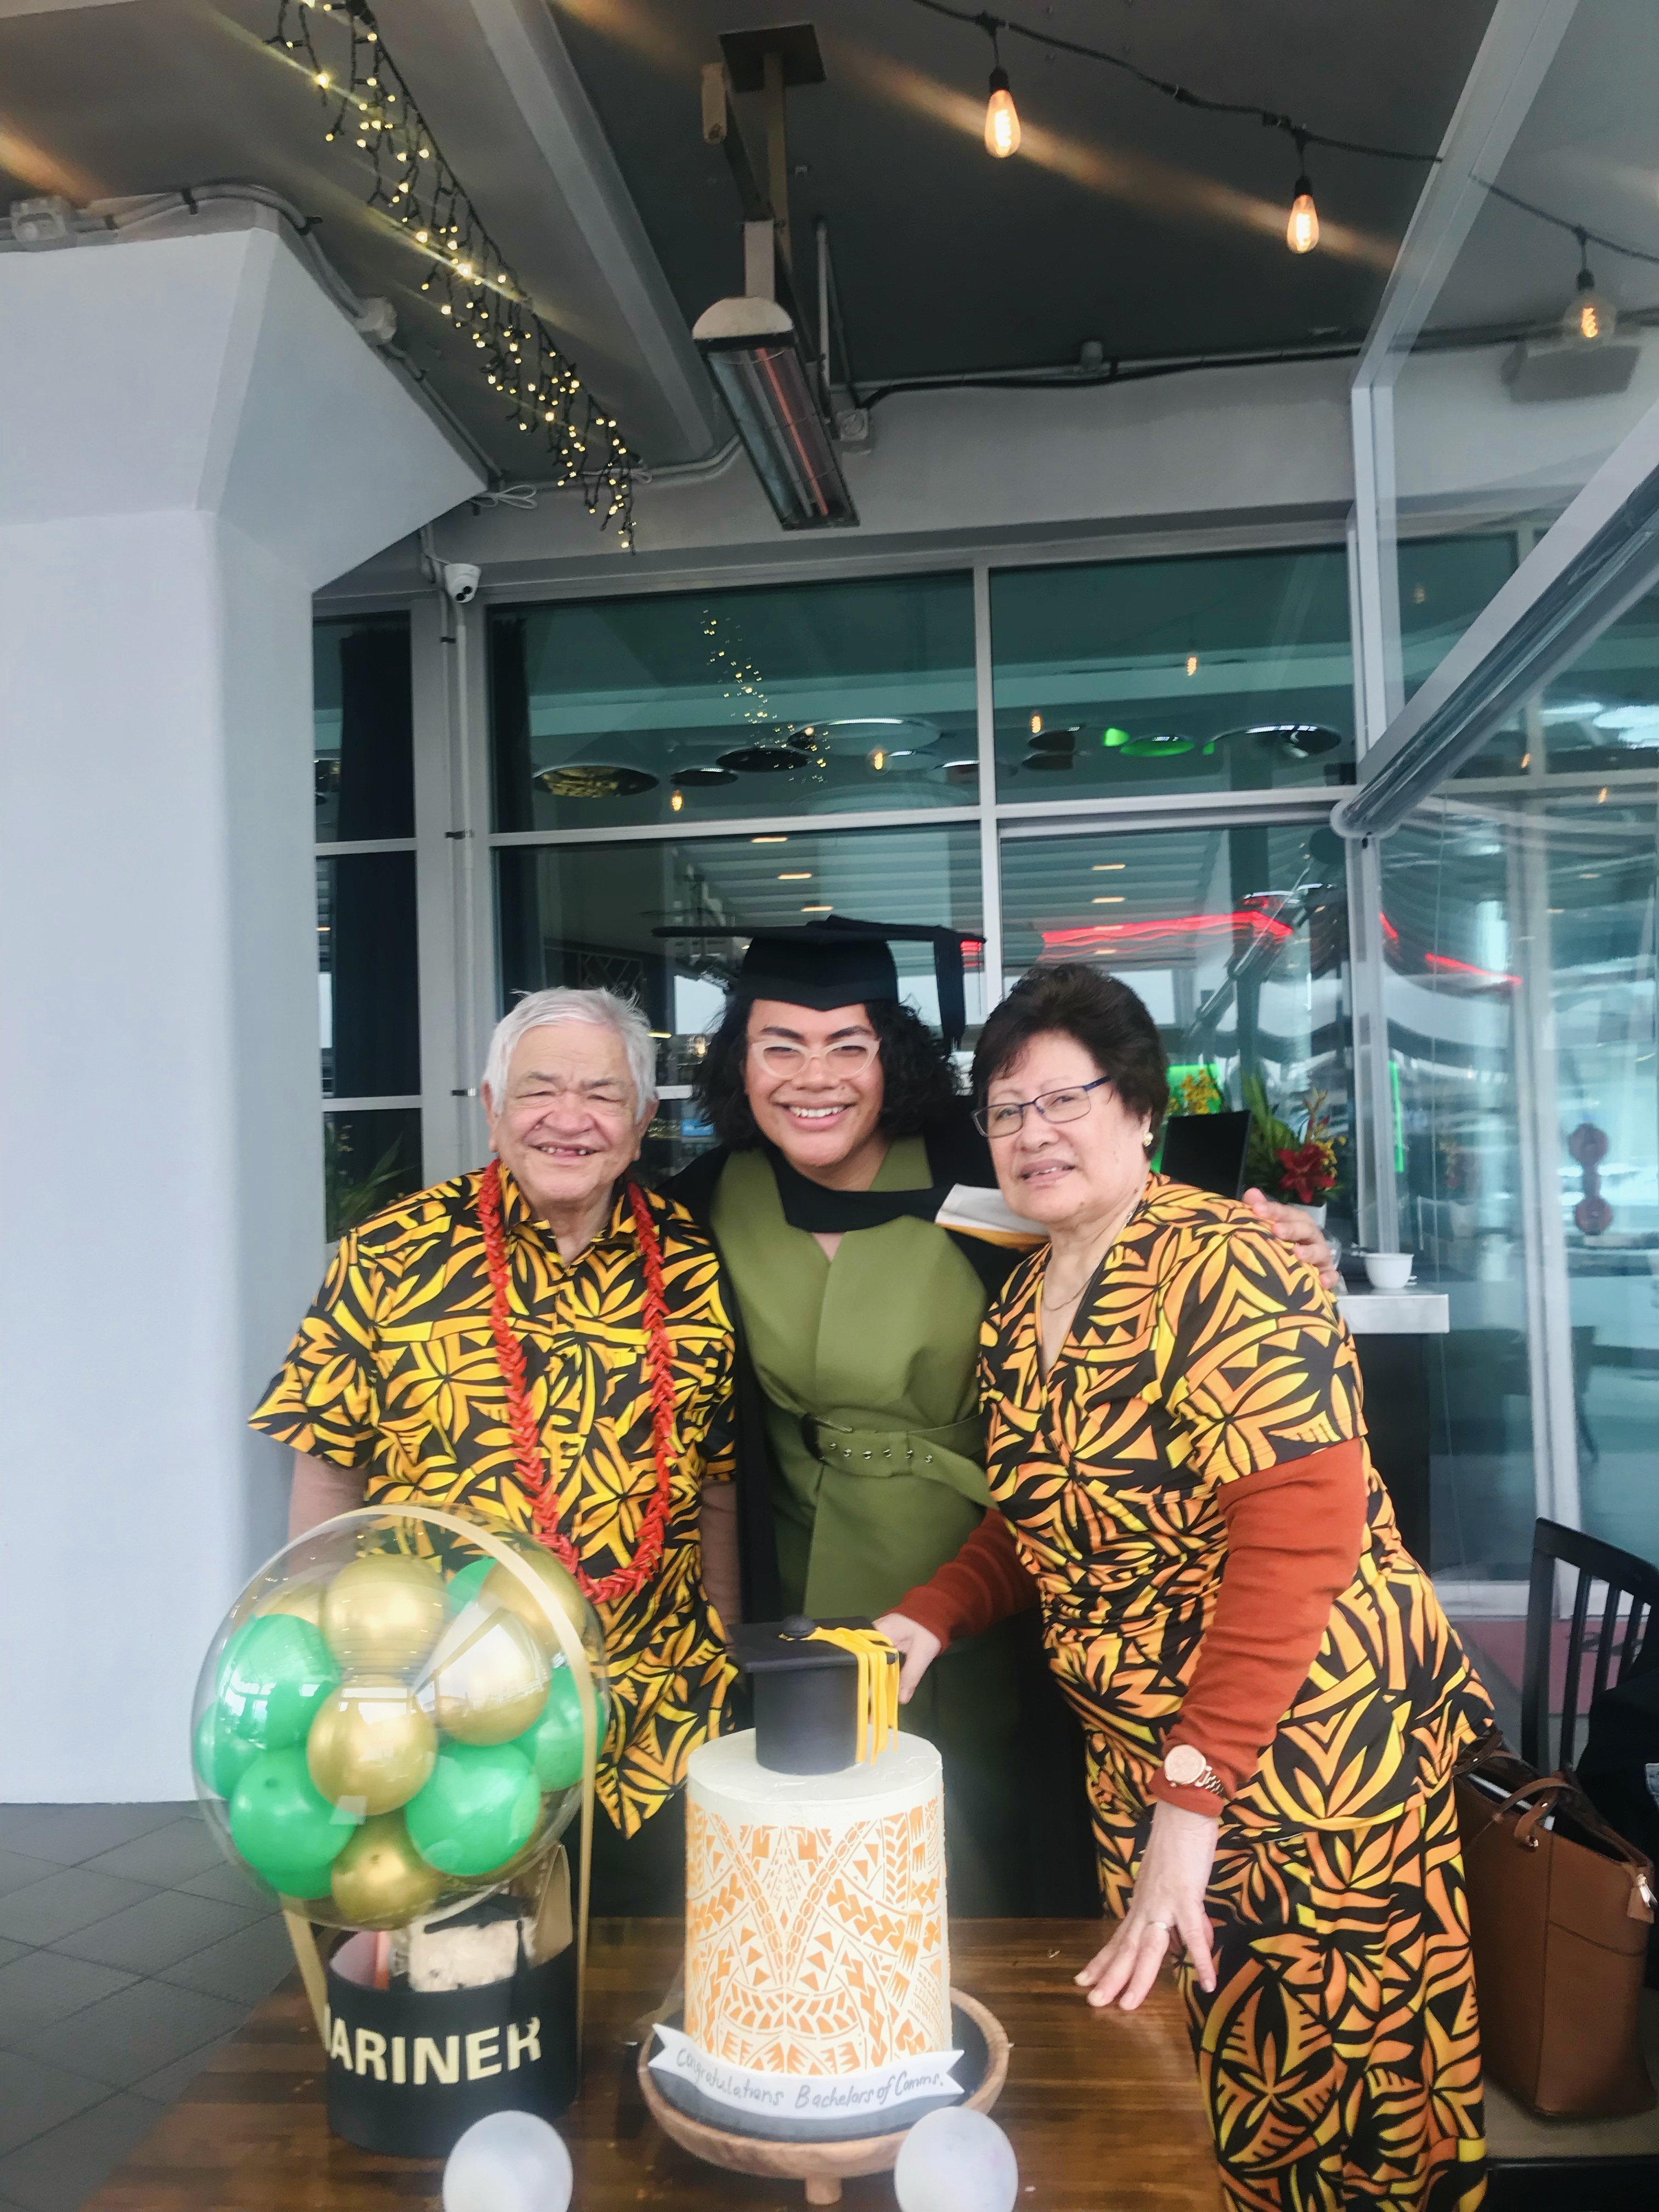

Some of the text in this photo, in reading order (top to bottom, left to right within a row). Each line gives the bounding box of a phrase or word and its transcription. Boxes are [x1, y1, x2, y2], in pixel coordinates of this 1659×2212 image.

[324, 2003, 542, 2085] ARINER
[676, 2047, 785, 2106] Congratulations
[794, 2084, 874, 2109] Bachelors
[876, 2074, 896, 2106] of
